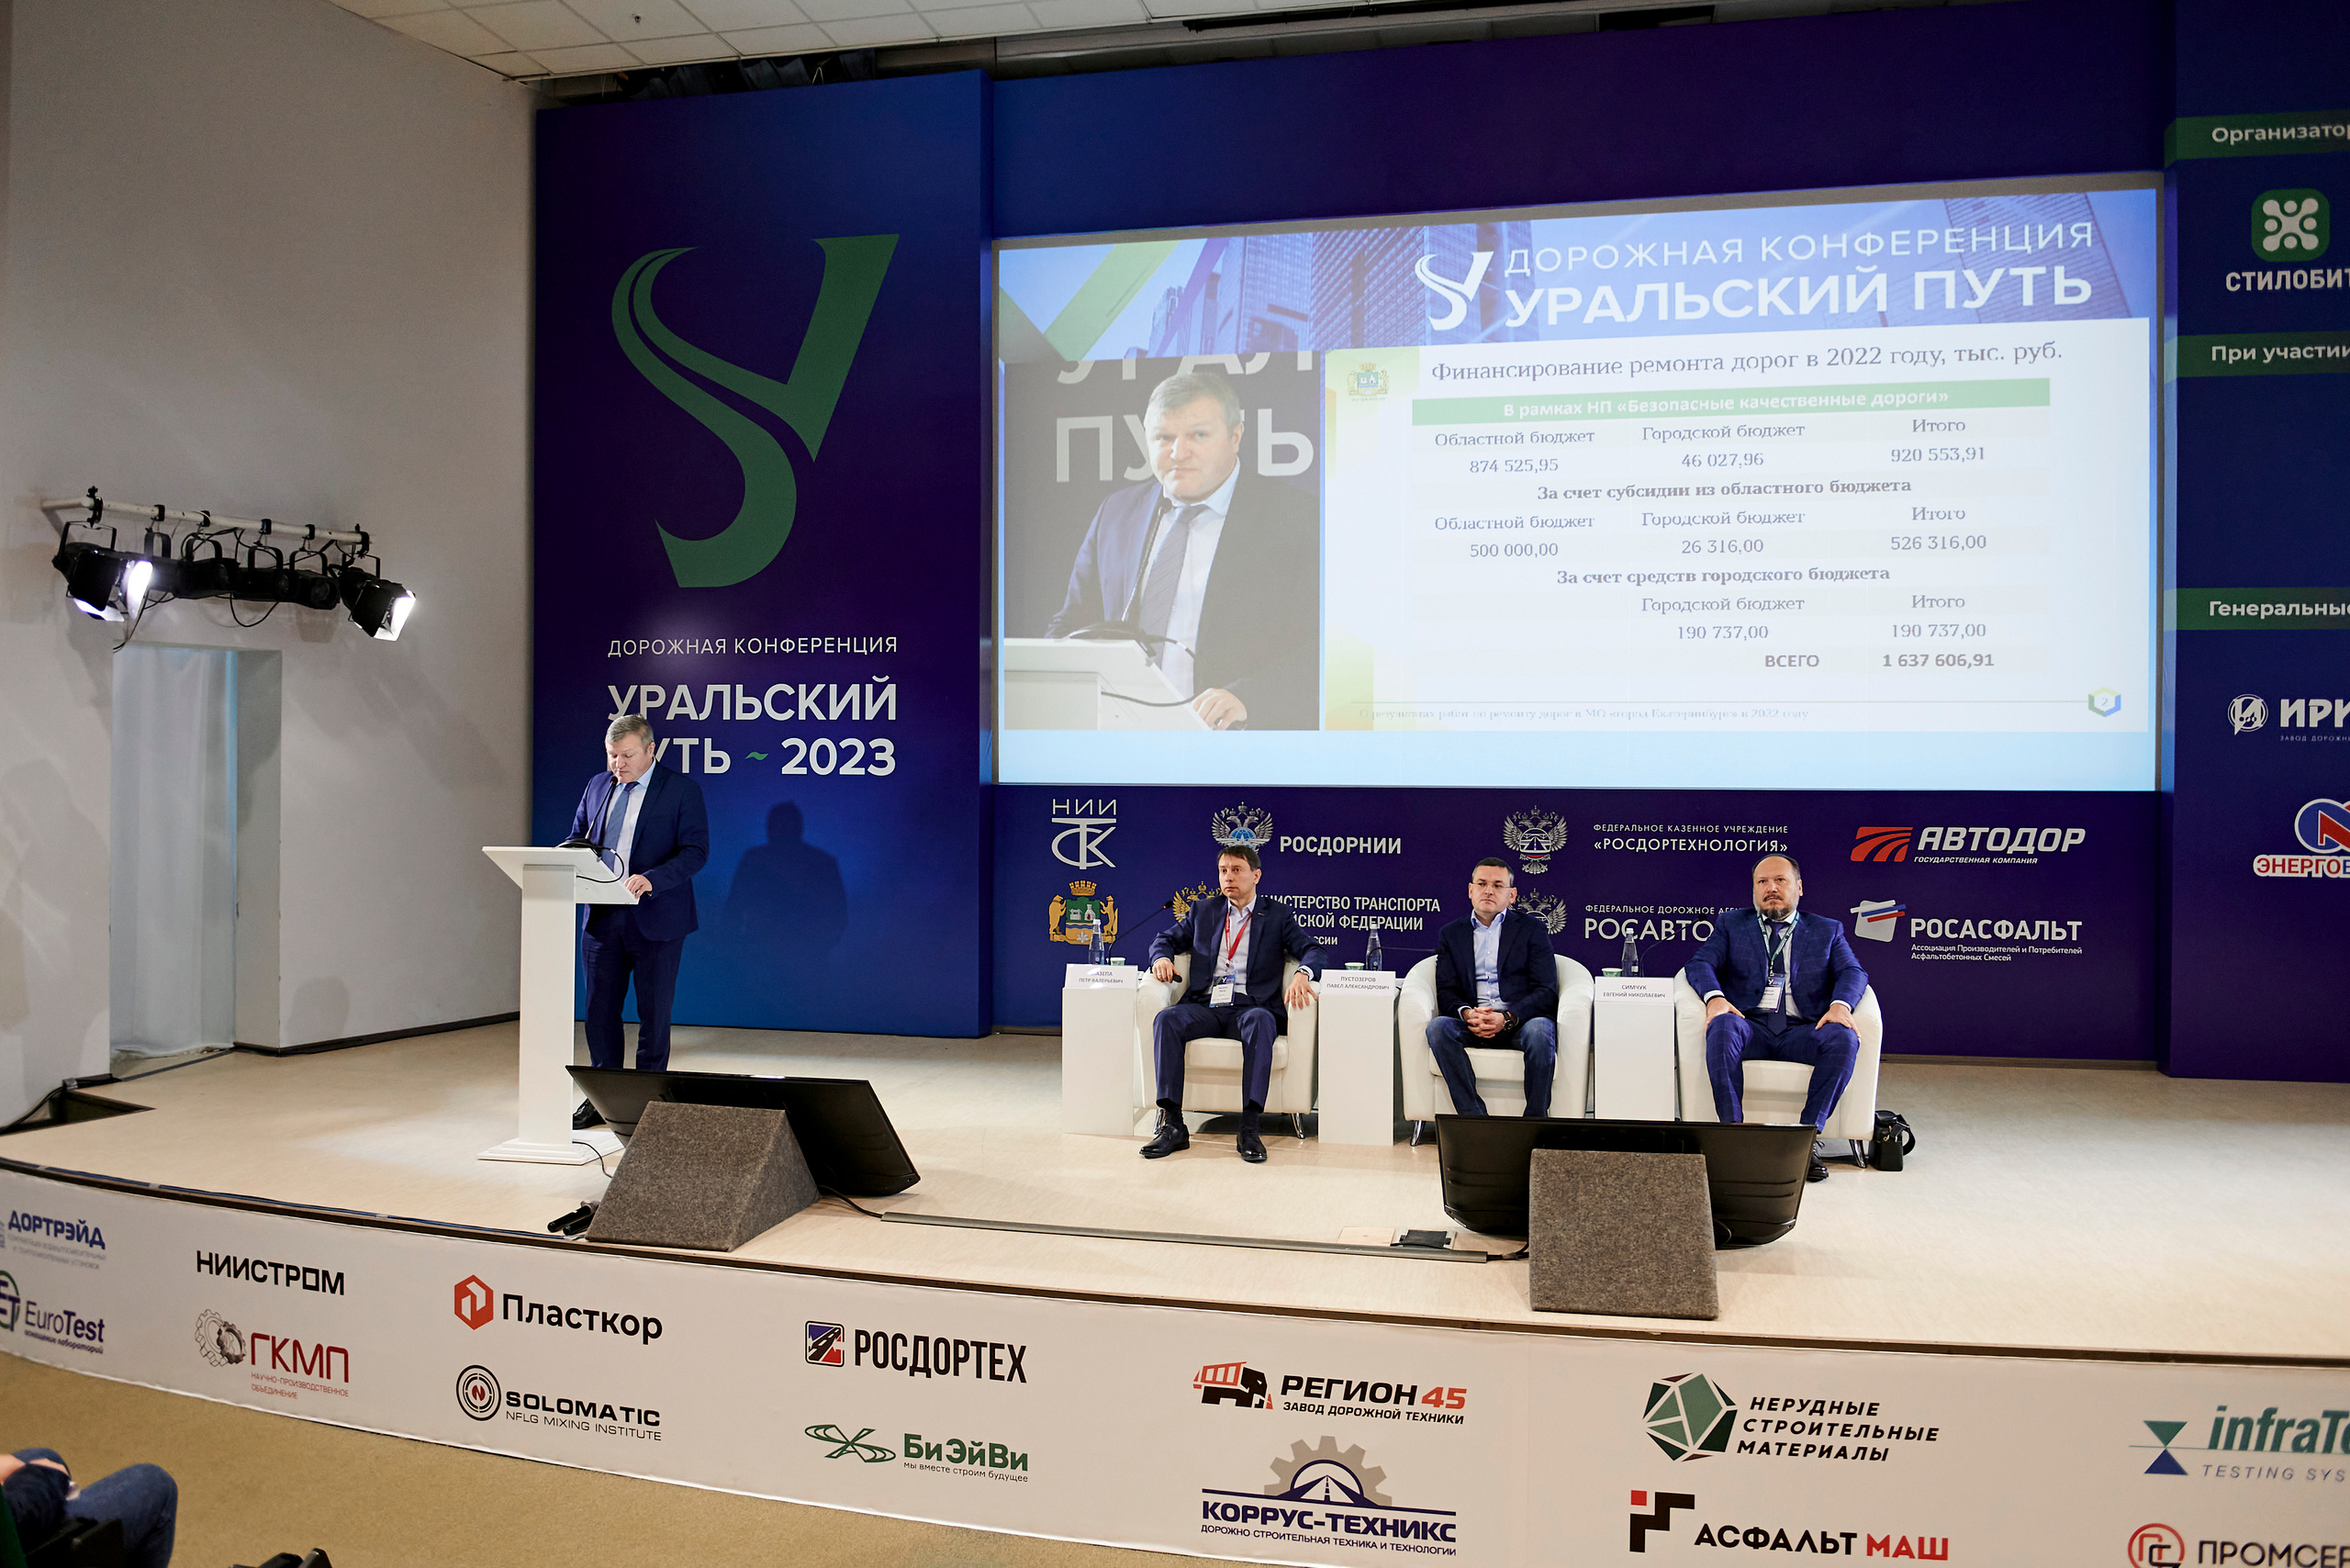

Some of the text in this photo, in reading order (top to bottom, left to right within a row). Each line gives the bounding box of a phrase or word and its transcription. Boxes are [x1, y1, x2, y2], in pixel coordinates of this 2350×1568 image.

[1505, 221, 2093, 278] ДОРОЖНАЯ КОНФЕРЕНЦИЯ
[1505, 264, 2093, 328] УРАЛЬСКИЙ ПУТЬ
[1432, 341, 2063, 382] Финансирование ремонта дорог в 2022 году, тыс. руб.
[2211, 345, 2256, 364] При
[1504, 390, 1949, 419] В рамках НП «Безопасные качественные дороги»
[1642, 424, 1806, 442] Городской бюджет
[1911, 419, 1966, 433] Итого
[1435, 431, 1595, 447] Областной бюджет
[1681, 453, 1763, 469] 46 027,96
[1891, 446, 1985, 464] 920 553,91
[1469, 458, 1559, 475] 874 525,95
[1537, 480, 1912, 501] За счет субсидии из областного бюджета
[1435, 516, 1595, 531] Областной бюджет
[1641, 510, 1806, 529] Городской бюджет
[1911, 507, 1966, 521] Итого
[1469, 543, 1559, 559] 500 000,00
[1681, 539, 1763, 554] 26 316,00
[1891, 534, 1987, 552] 526 316,00
[1557, 566, 1891, 587] За счет средств городского бюджета
[1641, 596, 1806, 614] Городской бюджет
[1911, 594, 1966, 610] Итого
[2209, 599, 2350, 620] Генеральны
[1677, 624, 1770, 642] 190 737,00
[1891, 622, 1987, 640] 190 737,00
[608, 636, 898, 658] ДОРОЖНАЯ КОНФЕРЕНЦИЯ
[1764, 654, 1820, 668] ВСЕГО
[1883, 654, 1996, 670] 1 637 606,91
[608, 675, 897, 721] УРАЛЬСКИЙ
[780, 737, 897, 777] 2023
[1052, 798, 1117, 816] НИИ
[1593, 823, 1788, 835] ФЕДЕРАЛЬНОЕ КАЗЕННОЕ УЧРЕЖДЕНИЕ
[1280, 835, 1402, 856] РОСДОРНИИ
[1595, 837, 1789, 854] «РОСДОРТЕХНОЛОГИЯ»
[1917, 826, 2087, 855] АВТОДОР
[1914, 856, 2038, 865] ГОСУДАРСТВЕННАЯ КОМПАНИЯ
[1354, 896, 1441, 913] ТРАНСПОРТА
[1584, 904, 1655, 914] ФЕДЕРАЛЬНОЕ
[1657, 905, 1715, 915] ДОРОЖНОЕ
[1338, 915, 1424, 933] ФЕДЕРАЦИИ
[1584, 917, 1715, 942] РОСАВТО
[1910, 918, 2083, 941] РОСАСФАЛЬТ
[1911, 944, 1956, 953] Ассоциация
[1957, 944, 2020, 954] Производителей
[2028, 945, 2083, 955] Потребителей
[1911, 952, 2012, 962] Асфальтобетонных Смесей
[8, 1210, 106, 1250] ДОРТРЭЙД
[196, 1249, 345, 1295] НИИСТРОМ
[25, 1300, 105, 1343] EuroTest
[503, 1293, 663, 1346] Пласткор
[251, 1332, 349, 1383] ГКМП
[855, 1328, 1027, 1383] РОСДОРТЕХ
[251, 1372, 349, 1397] НАУЧНО-ПРОИЗВОДСТВЕННОЕ
[251, 1383, 297, 1399] ОБЪЕДИНЕНИЕ
[1281, 1374, 1468, 1410] РЕГИОН 45
[506, 1391, 661, 1428] SOLOMATIC
[1282, 1401, 1465, 1425] ЗАВОД ДОРОЖНОЙ ТЕХНИКИ
[1750, 1395, 1881, 1417] НЕРУДНЫЕ
[506, 1411, 662, 1441] NFLG MIXING INSTITUTE
[1742, 1417, 1940, 1442] СТРОИТЕЛЬНЫЕ
[903, 1432, 1029, 1472] БиЭйВи
[1736, 1439, 1890, 1462] МАТЕРИАЛЫ
[919, 1463, 951, 1474] вместе
[953, 1468, 987, 1479] строим
[988, 1470, 1029, 1484] будущее
[2202, 1464, 2295, 1481] TESTING
[1202, 1500, 1457, 1543] КОРРУС-ТЕХНИКС
[1201, 1524, 1251, 1538] ДОРОЖНО
[1253, 1529, 1331, 1545] СТРОИТЕЛЬНАЯ
[1333, 1537, 1378, 1550] ТЕХНИКА
[1389, 1542, 1457, 1556] ТЕХНОЛОГИИ
[1694, 1522, 1949, 1561] АСФАЛЬТ МАШ
